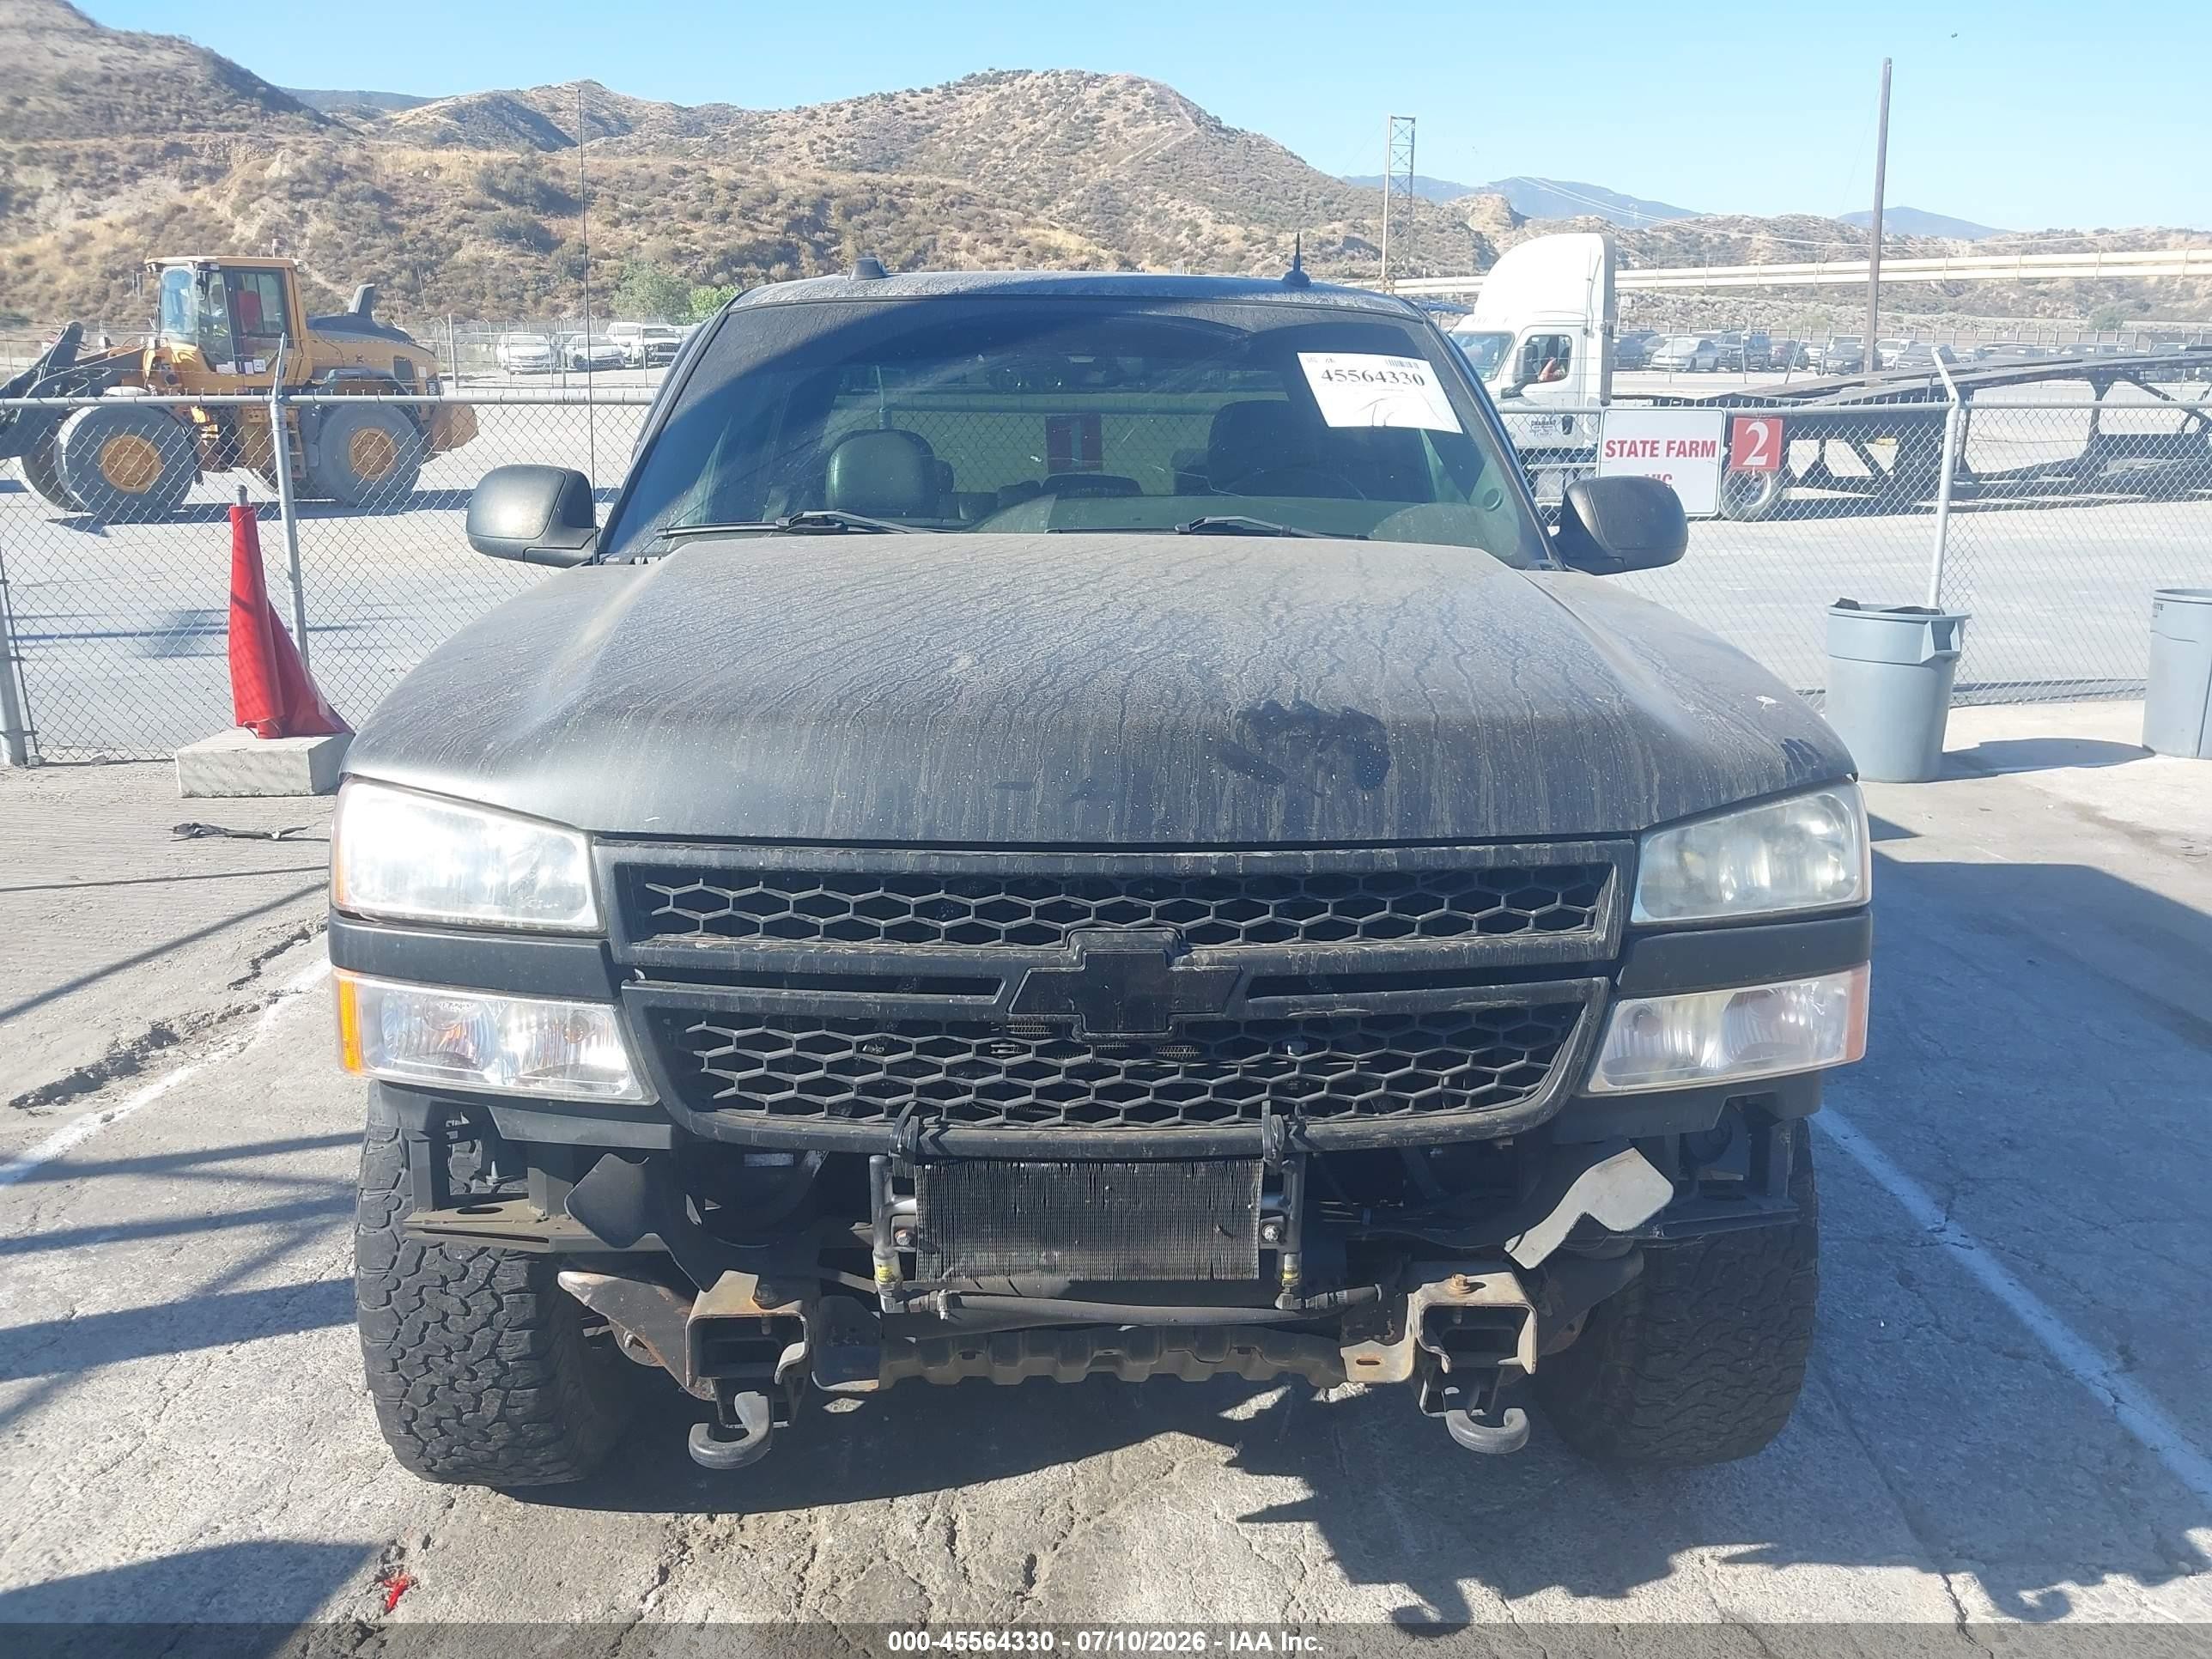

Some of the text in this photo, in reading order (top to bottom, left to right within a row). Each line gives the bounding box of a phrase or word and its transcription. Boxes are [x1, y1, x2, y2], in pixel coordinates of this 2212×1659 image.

[1321, 368, 1425, 386] 45564330
[1604, 440, 1717, 459] STATE FARM
[1742, 422, 1769, 466] 2
